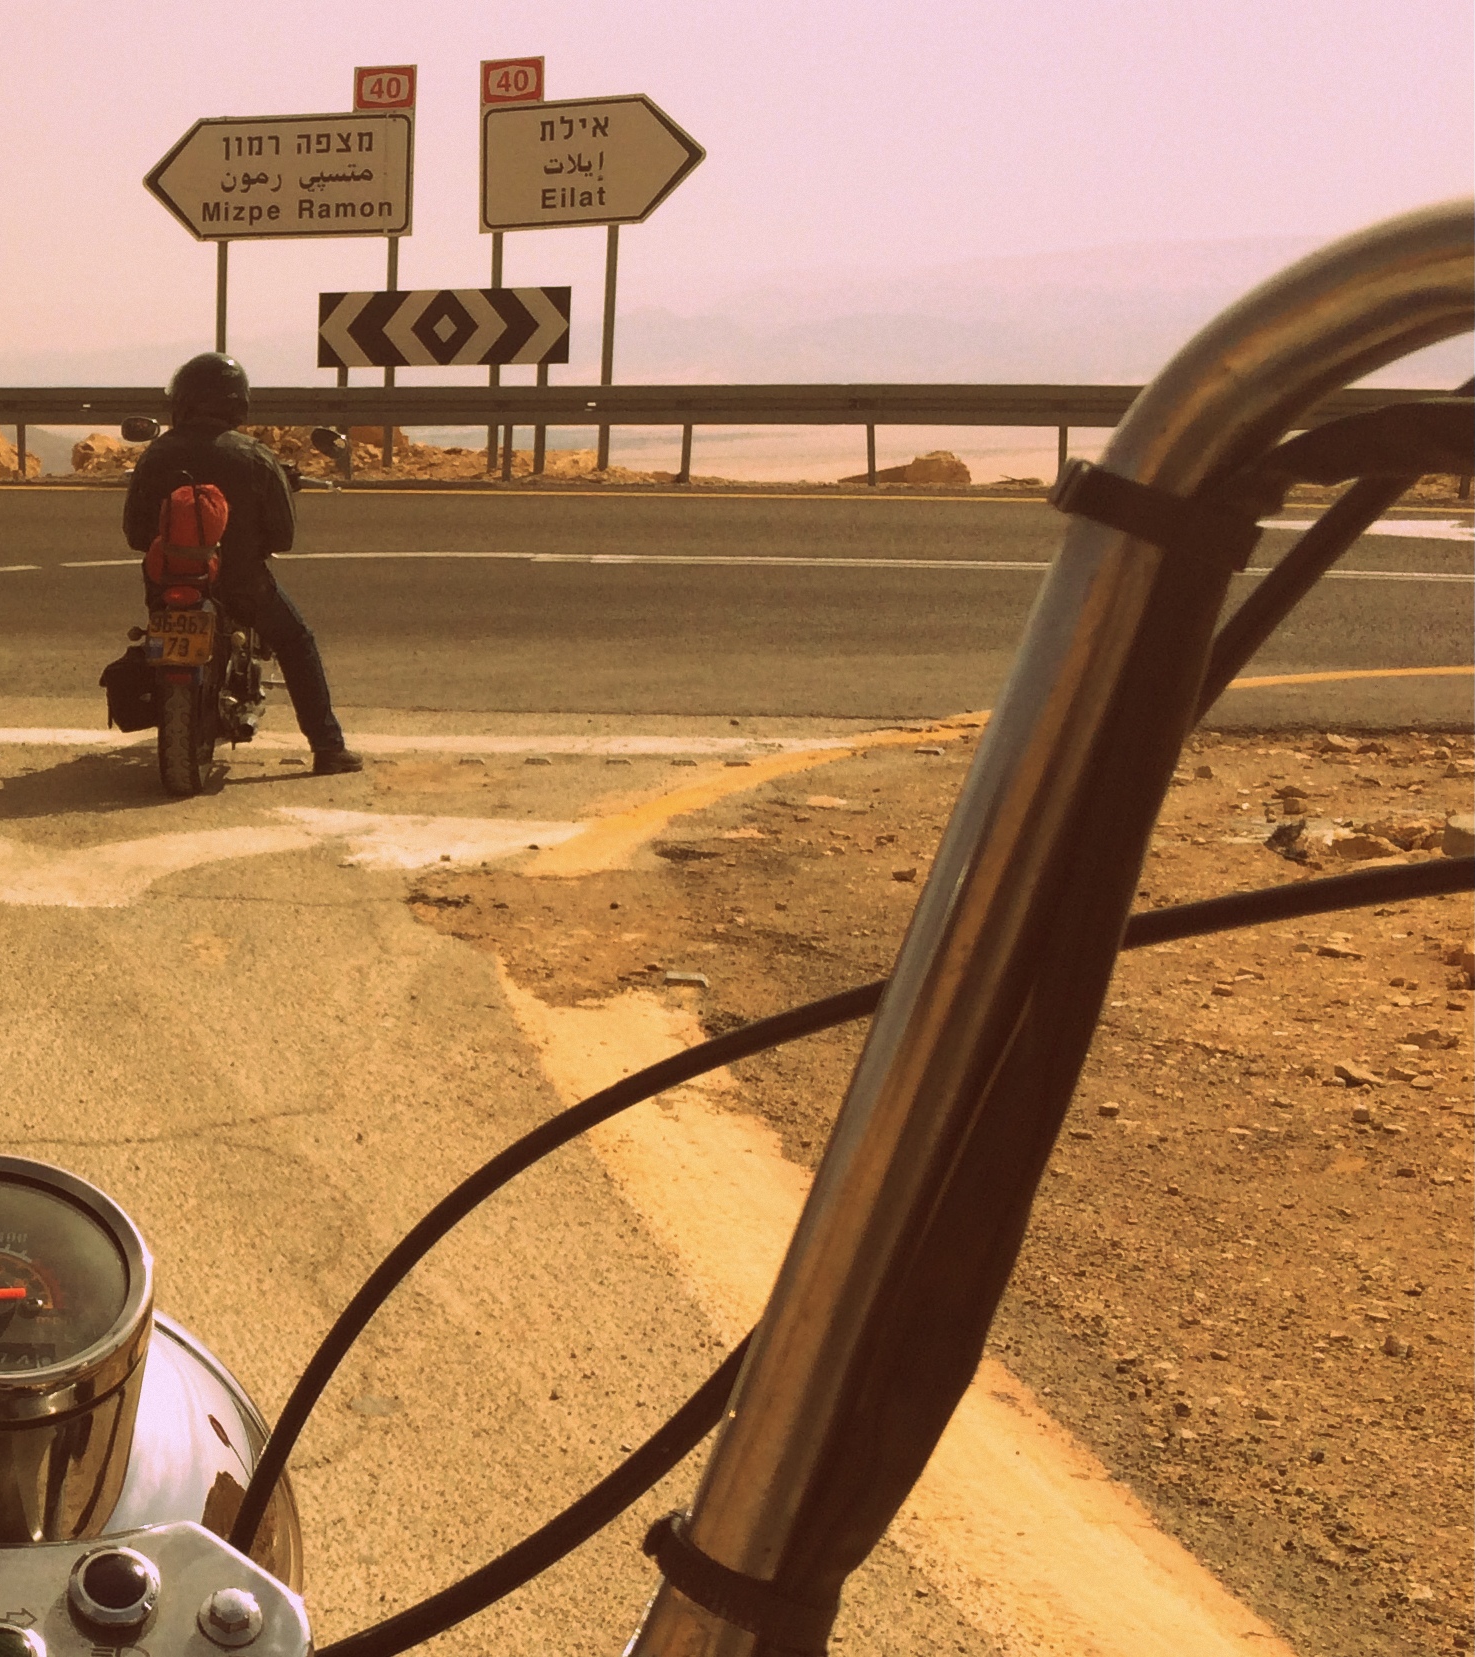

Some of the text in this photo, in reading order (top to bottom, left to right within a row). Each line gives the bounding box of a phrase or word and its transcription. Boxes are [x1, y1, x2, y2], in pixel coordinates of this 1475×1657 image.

[370, 77, 401, 99] 40
[496, 69, 529, 92] 40
[540, 115, 609, 141] אילת
[222, 131, 373, 161] מצפה רמון
[543, 150, 604, 181] إيلات
[221, 171, 282, 193] رمون
[541, 186, 606, 209] Eilat
[202, 198, 393, 226] Mizpe Ramon
